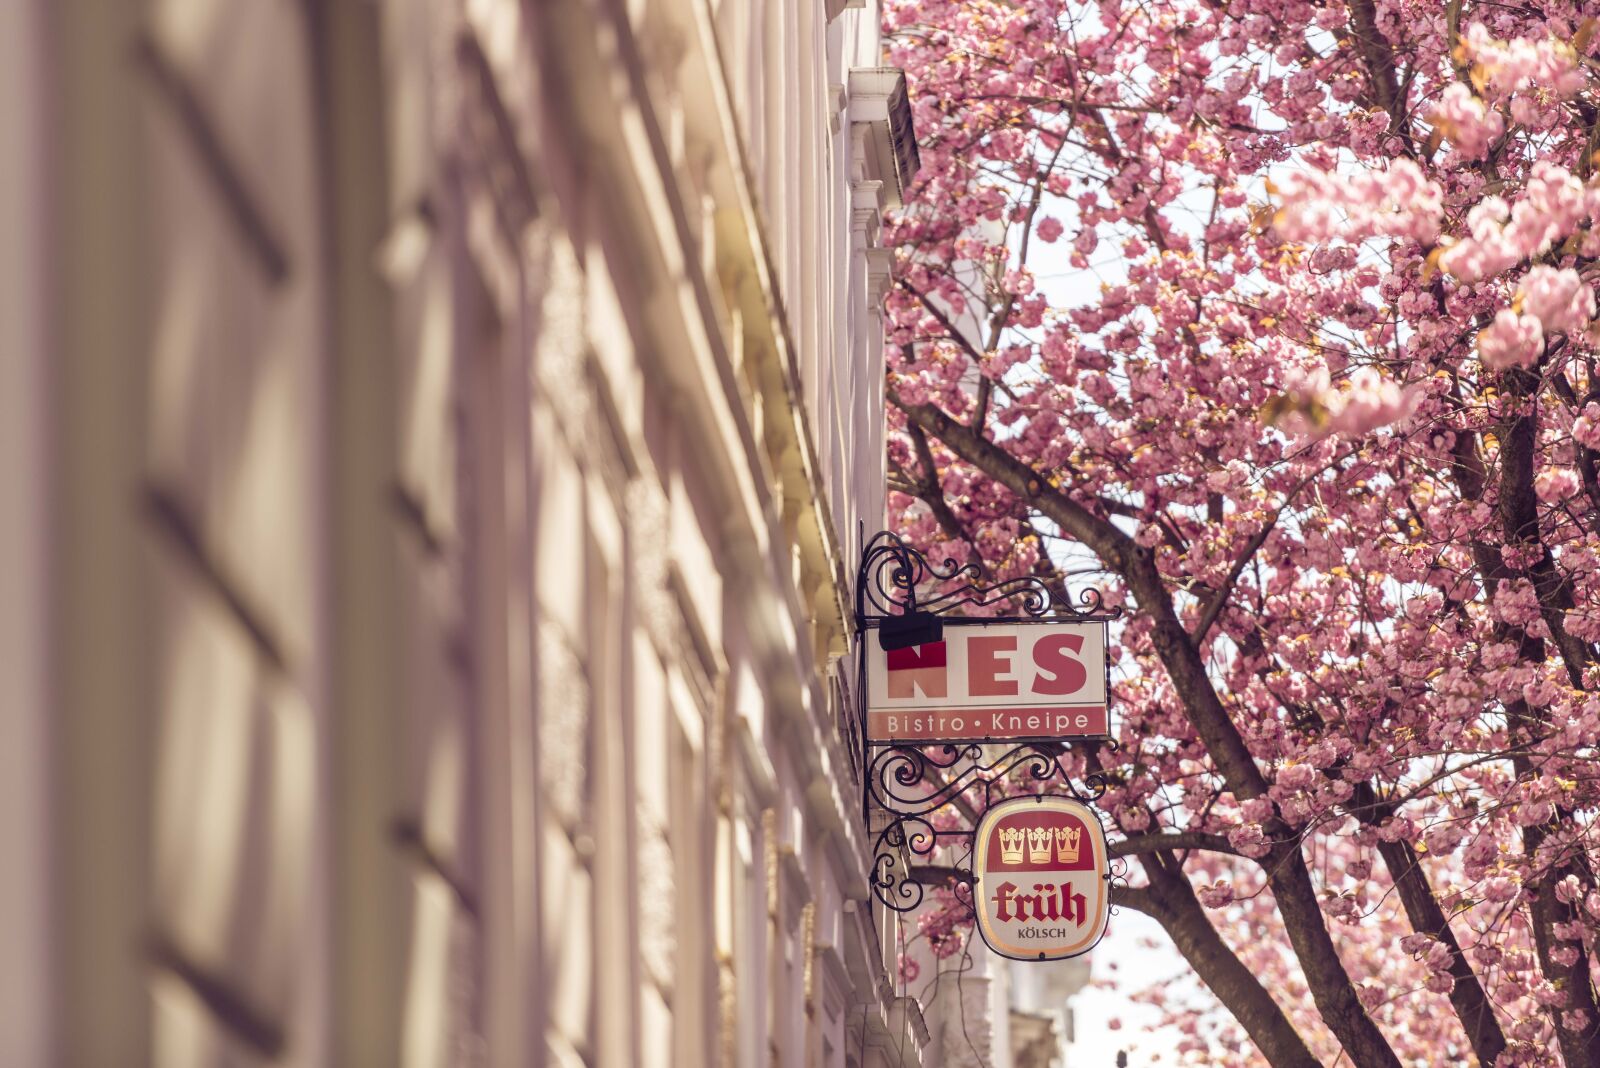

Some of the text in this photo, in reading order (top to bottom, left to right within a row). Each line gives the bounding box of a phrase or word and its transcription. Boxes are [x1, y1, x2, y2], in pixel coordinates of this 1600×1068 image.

[886, 633, 1087, 699] NES
[887, 712, 1089, 733] Bistro Kneipe
[991, 881, 1088, 929] früh
[1017, 927, 1067, 939] KÖLSCH
